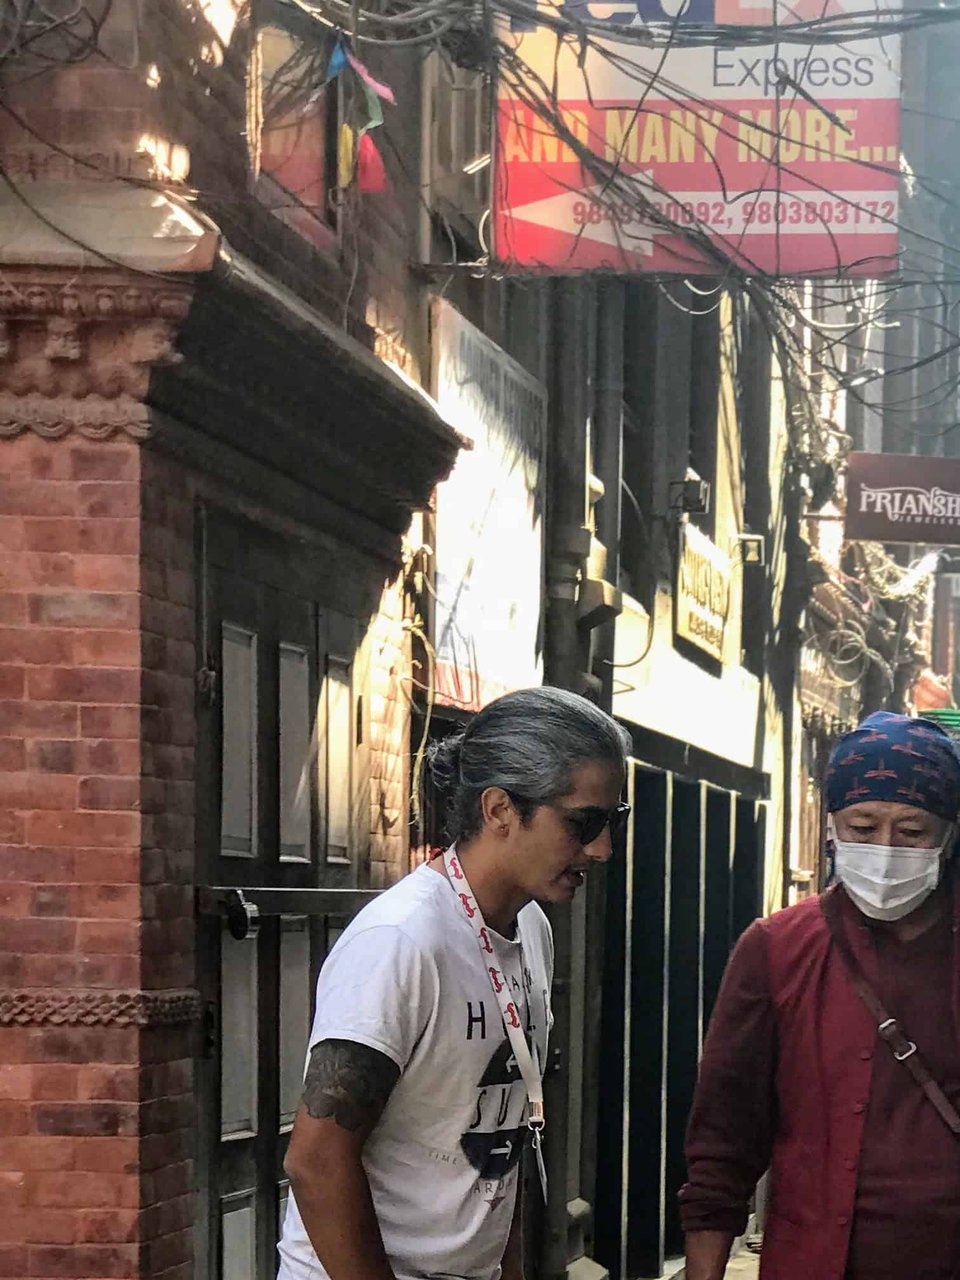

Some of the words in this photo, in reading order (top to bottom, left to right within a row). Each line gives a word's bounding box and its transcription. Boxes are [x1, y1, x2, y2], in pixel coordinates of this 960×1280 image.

[713, 47, 874, 96] Express
[506, 108, 589, 163] AND
[605, 108, 727, 163] MANY
[737, 109, 897, 163] MORE...
[742, 201, 895, 225] 9803803172
